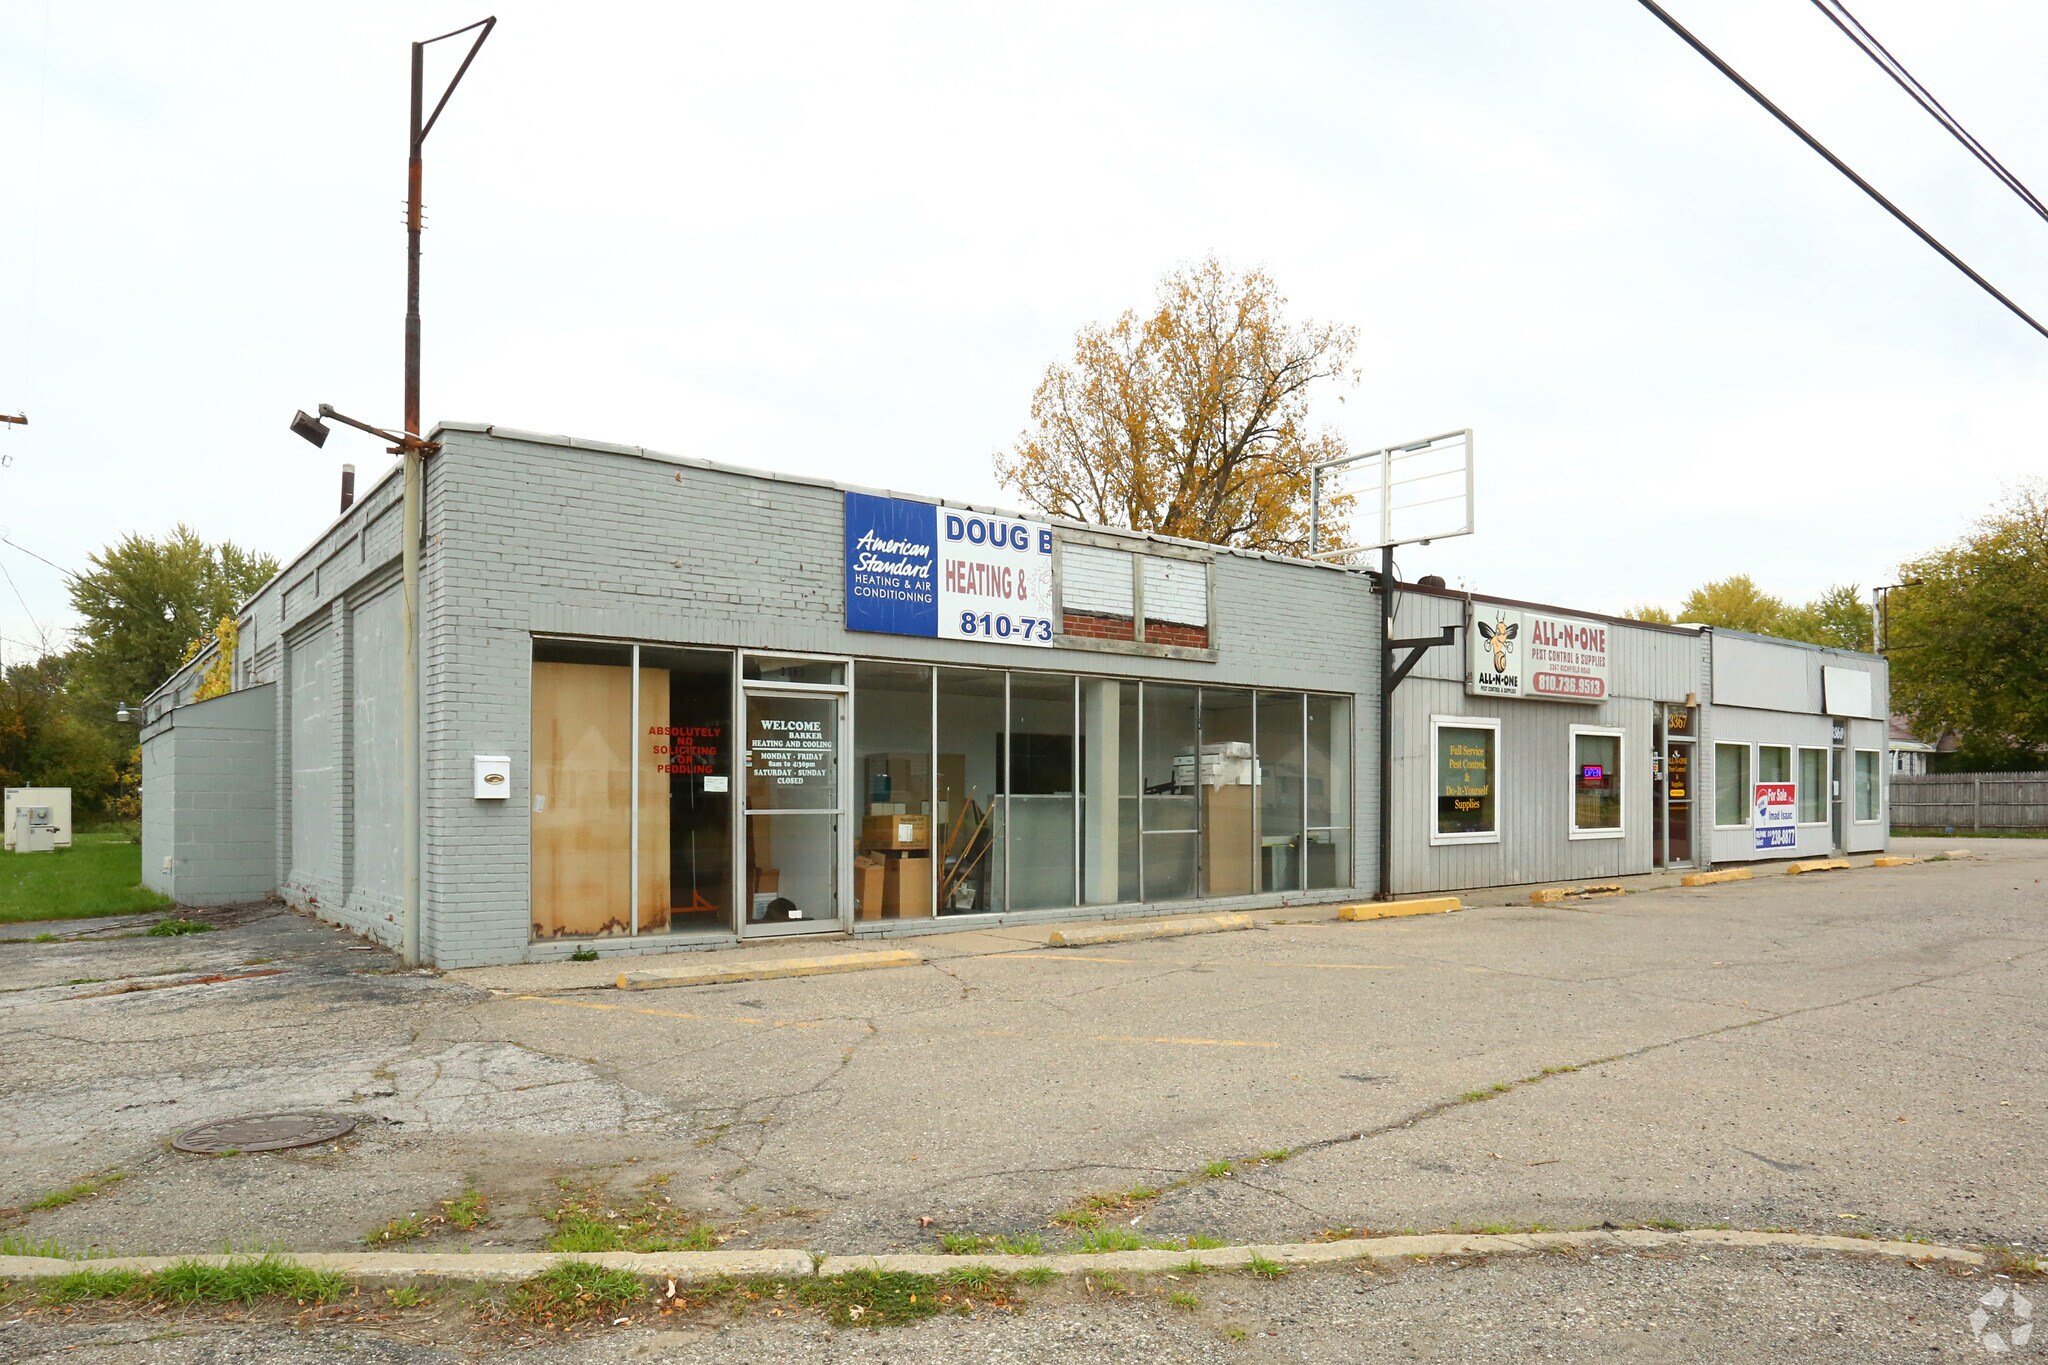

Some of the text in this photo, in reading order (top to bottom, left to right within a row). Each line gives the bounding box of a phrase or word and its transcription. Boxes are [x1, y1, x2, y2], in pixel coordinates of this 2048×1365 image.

[945, 514, 1029, 552] DOUG
[856, 528, 930, 559] American
[853, 552, 933, 579] Standard
[855, 574, 931, 591] HEATING & AIR
[945, 558, 1028, 600] HEATING &
[854, 586, 932, 604] CONDITIONING
[959, 611, 1053, 642] 810-73
[1532, 619, 1606, 653] ALL-N-ONE
[1532, 648, 1547, 660] PEST
[1549, 650, 1574, 663] CONTROL
[1581, 654, 1606, 667] SUPPLIES
[1479, 672, 1518, 687] ALL-N-ONE
[1538, 674, 1600, 694] 810.736.9513
[761, 720, 821, 731] WELCOME
[1669, 714, 1687, 728] 3367
[648, 726, 721, 737] ABSOLUTELY
[677, 737, 693, 746] NO
[653, 746, 717, 756] SOLICITING
[761, 752, 792, 760] MONDAY
[1450, 745, 1484, 756] Full Service
[677, 756, 693, 765] OR
[1449, 758, 1462, 769] Pest
[657, 764, 713, 774] PEDDLING
[1585, 768, 1601, 777] OPEN
[1464, 772, 1471, 782] &
[1446, 785, 1489, 796] Do-It-Yourself
[1767, 788, 1776, 801] For
[1777, 788, 1787, 801] Sale
[1454, 799, 1480, 811] Supplies
